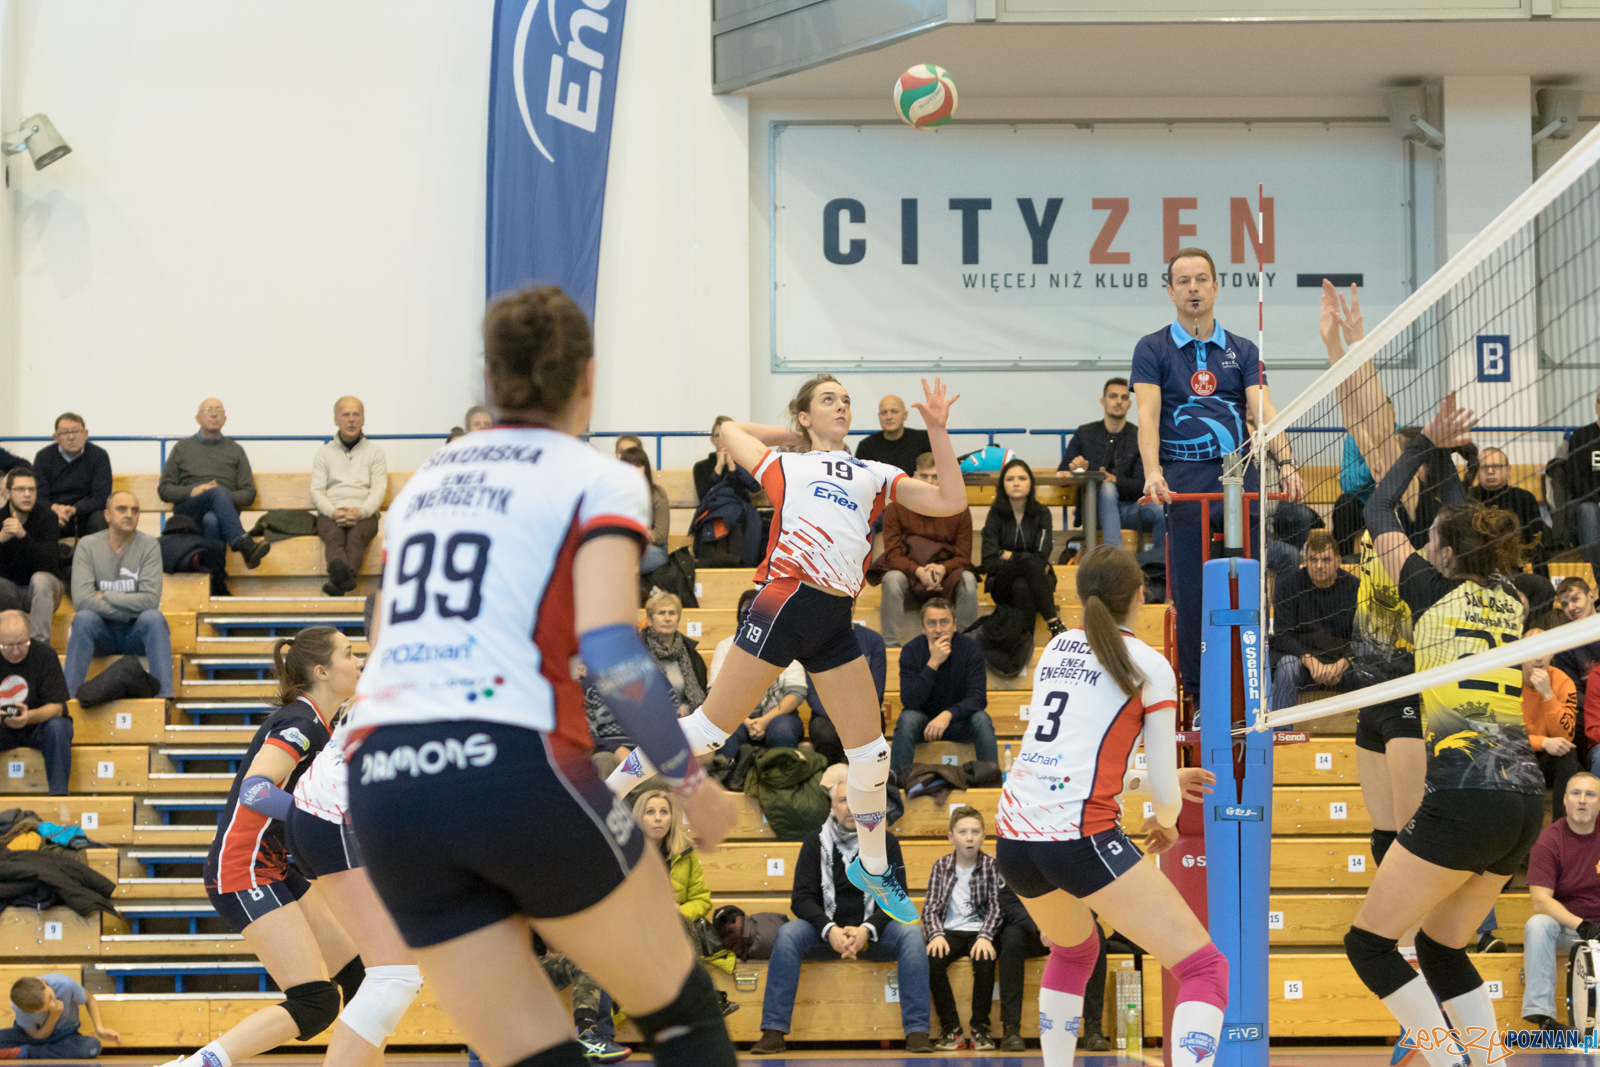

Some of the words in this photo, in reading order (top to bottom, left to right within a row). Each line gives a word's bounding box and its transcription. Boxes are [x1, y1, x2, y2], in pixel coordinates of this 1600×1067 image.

[546, 0, 611, 133] En
[822, 197, 1276, 265] CITYZEN
[962, 273, 1037, 292] WIĘCEJ
[1050, 271, 1083, 288] NIŻ
[1096, 273, 1148, 288] KLUB
[1161, 273, 1277, 288] STOWY
[1483, 343, 1504, 375] B
[423, 444, 544, 470] SIKORSKA
[821, 461, 853, 481] 19
[813, 486, 858, 511] Enea
[389, 531, 491, 625] 99
[746, 623, 763, 644] 19
[1052, 639, 1093, 655] JURCZ
[1060, 658, 1086, 668] ENEA
[1040, 667, 1102, 686] ENERGETYK
[1245, 647, 1259, 699] Senoh
[1034, 691, 1069, 742] 3
[1277, 733, 1306, 742] Senoh
[1319, 756, 1329, 764] 14
[1334, 805, 1344, 813] 14
[1107, 841, 1123, 855] 3
[1352, 858, 1361, 866] 14
[1270, 915, 1280, 923] 15
[1288, 984, 1299, 992] 15
[1488, 984, 1499, 993] 13
